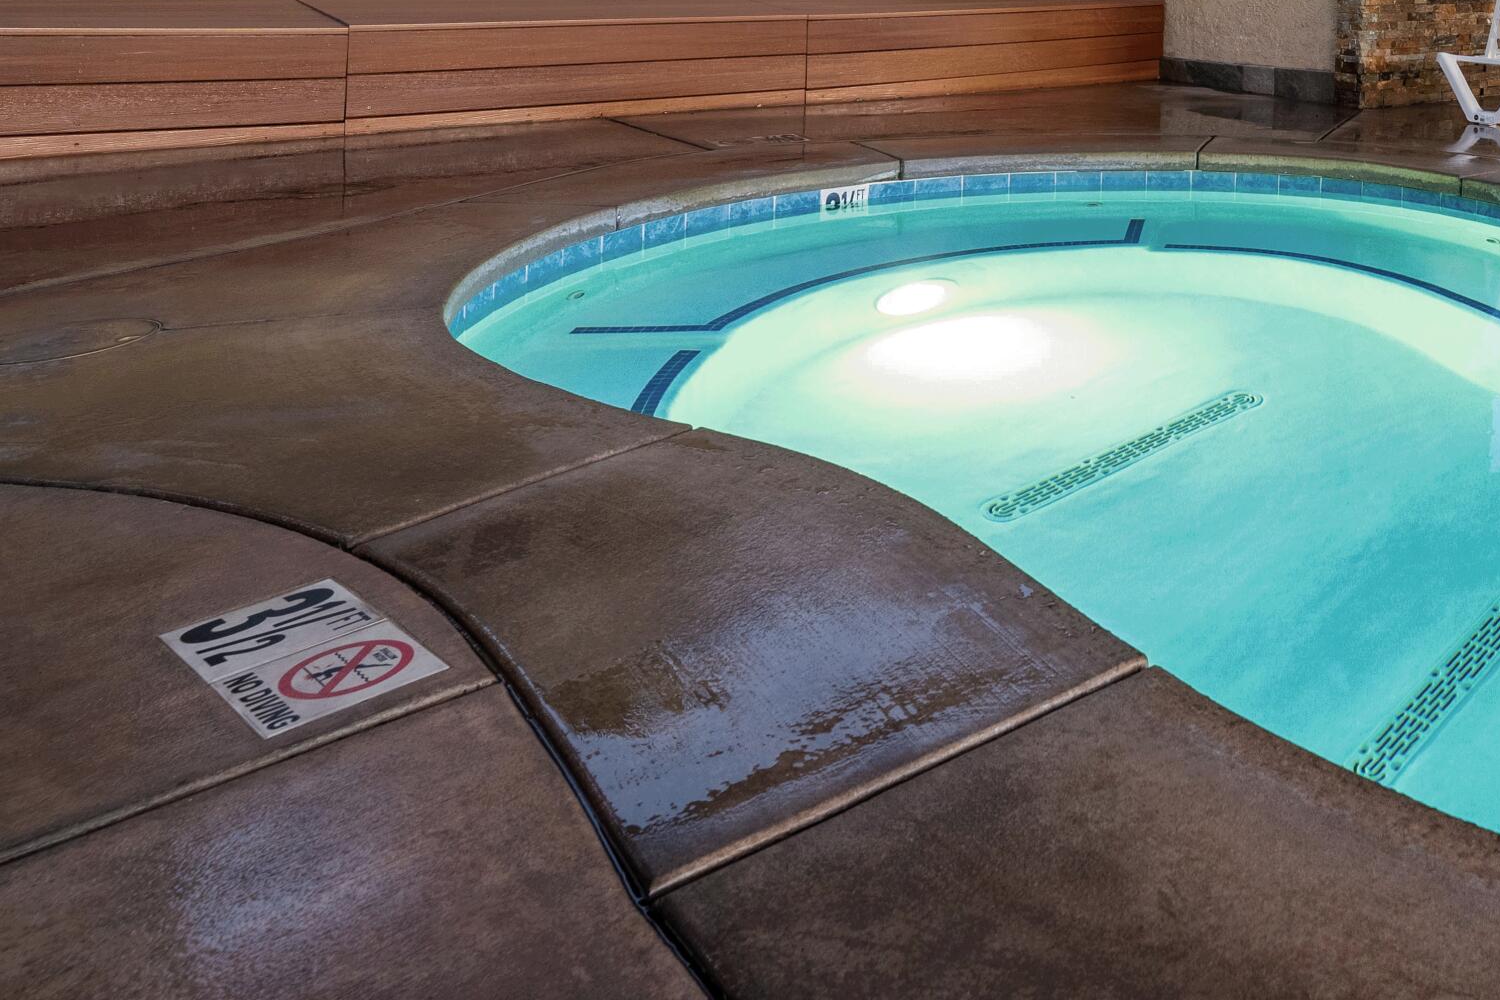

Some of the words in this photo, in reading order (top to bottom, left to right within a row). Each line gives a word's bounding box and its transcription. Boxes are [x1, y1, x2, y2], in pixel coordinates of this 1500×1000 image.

[326, 611, 372, 631] FT
[223, 672, 264, 694] NO
[239, 687, 300, 731] DIVING
